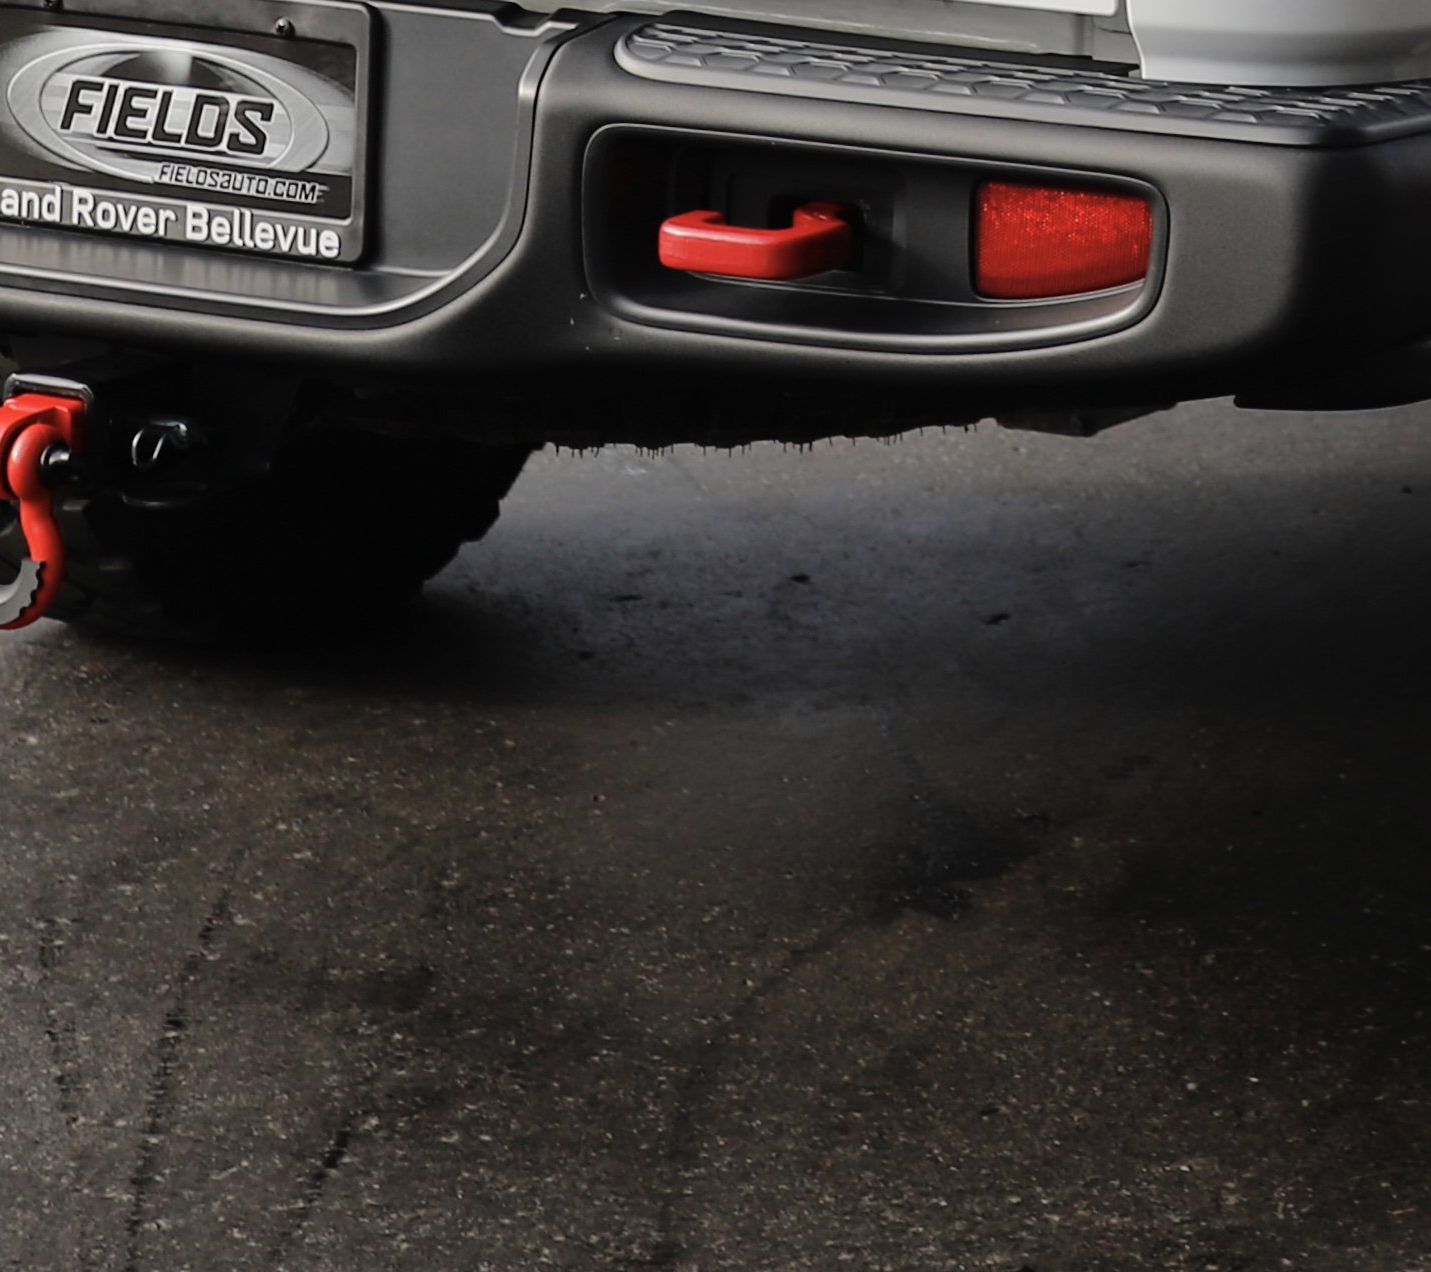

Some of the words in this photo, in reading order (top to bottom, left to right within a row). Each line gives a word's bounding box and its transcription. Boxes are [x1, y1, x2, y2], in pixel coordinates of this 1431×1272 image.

[58, 78, 276, 156] FIELDS
[72, 191, 176, 237] Rover
[184, 204, 342, 259] Bellevue
